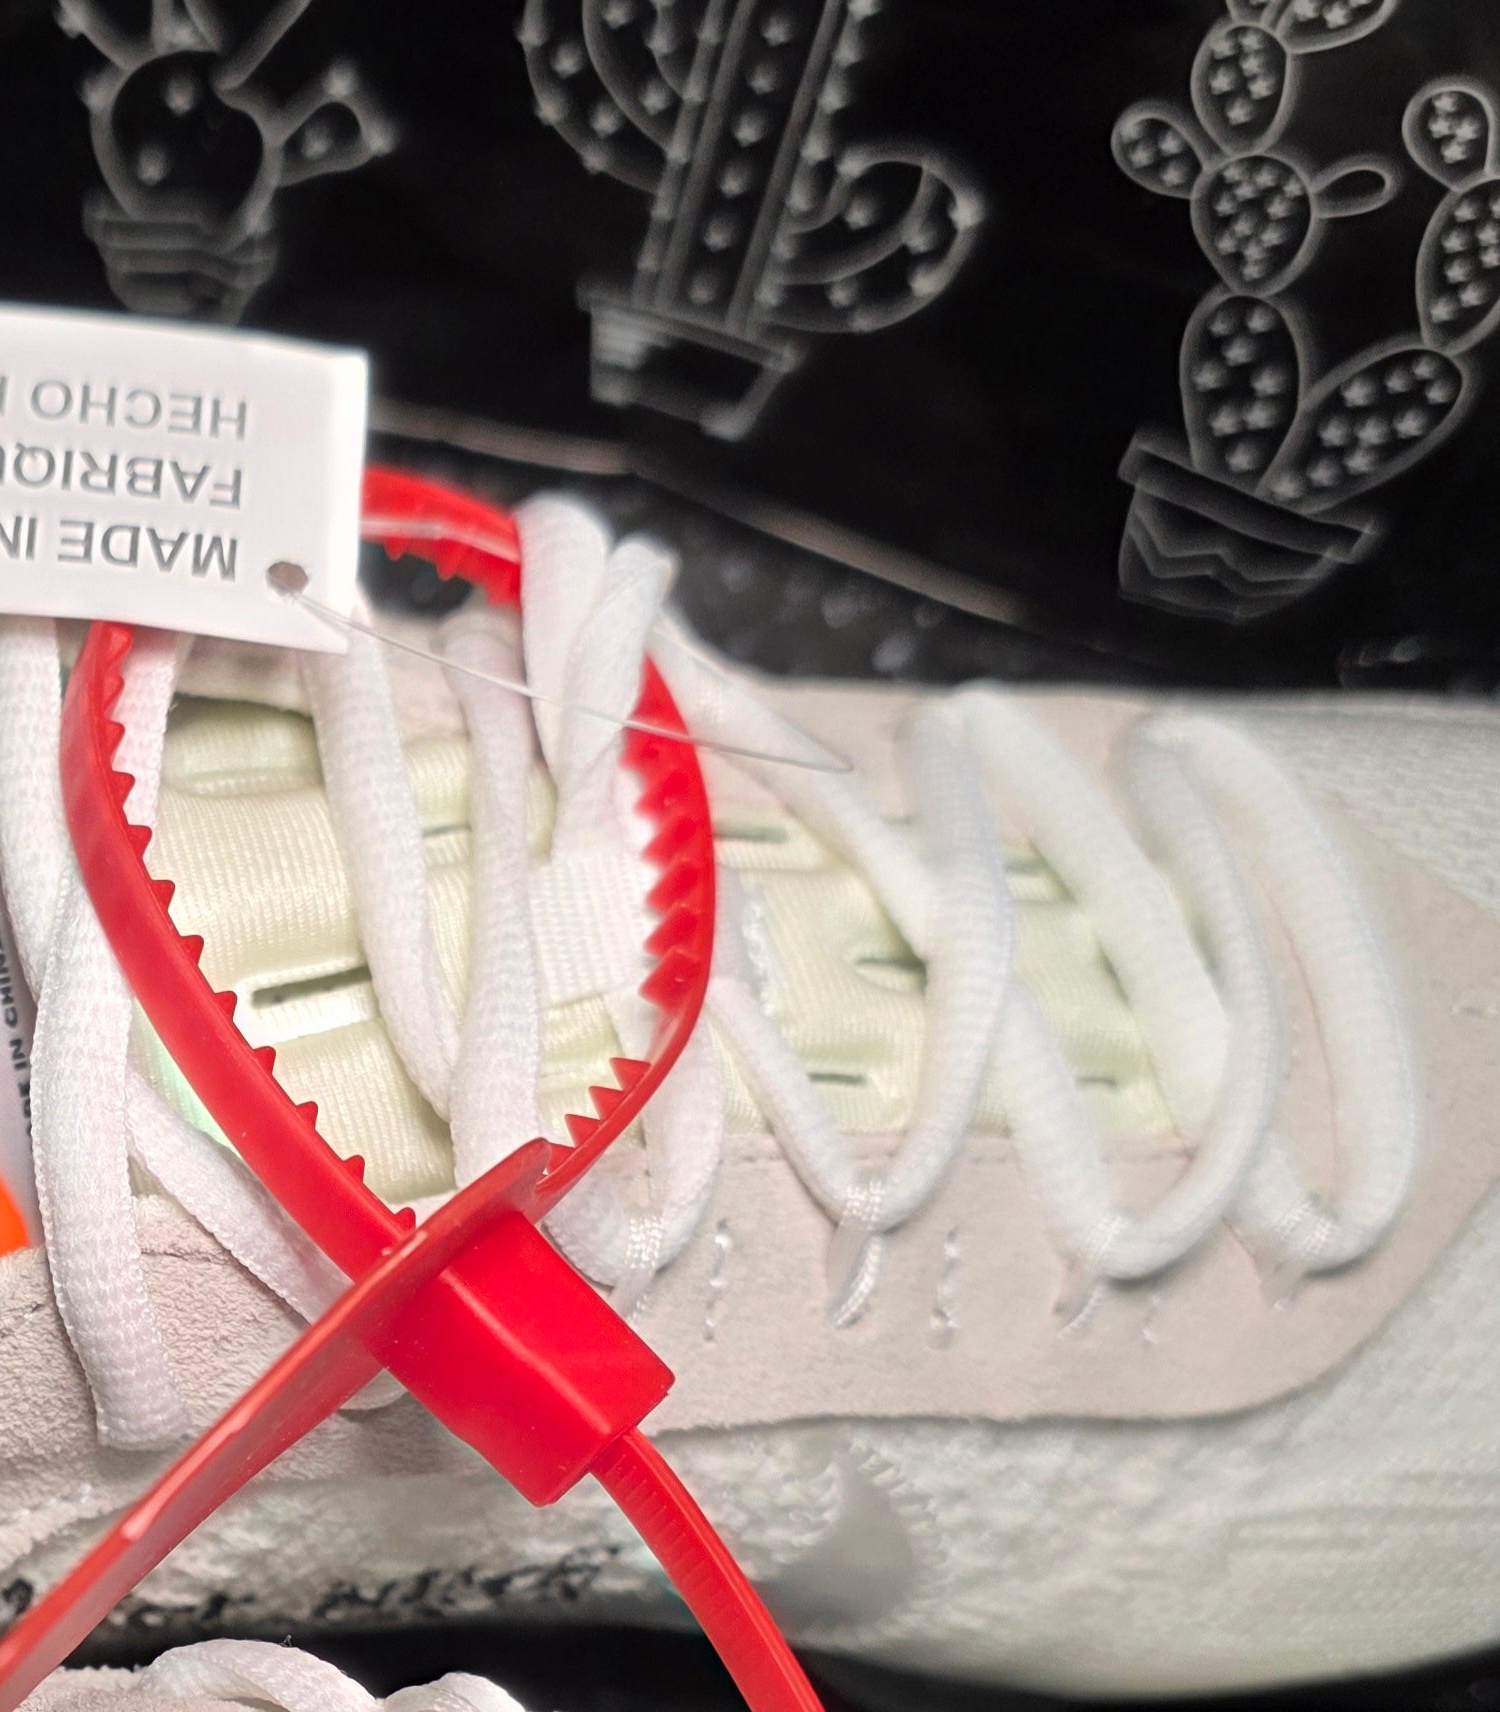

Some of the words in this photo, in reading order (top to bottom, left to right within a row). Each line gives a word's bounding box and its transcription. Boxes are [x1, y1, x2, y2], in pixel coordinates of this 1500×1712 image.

[30, 379, 248, 440] HECHO
[58, 520, 240, 582] MADE
[9, 1037, 29, 1071] IN
